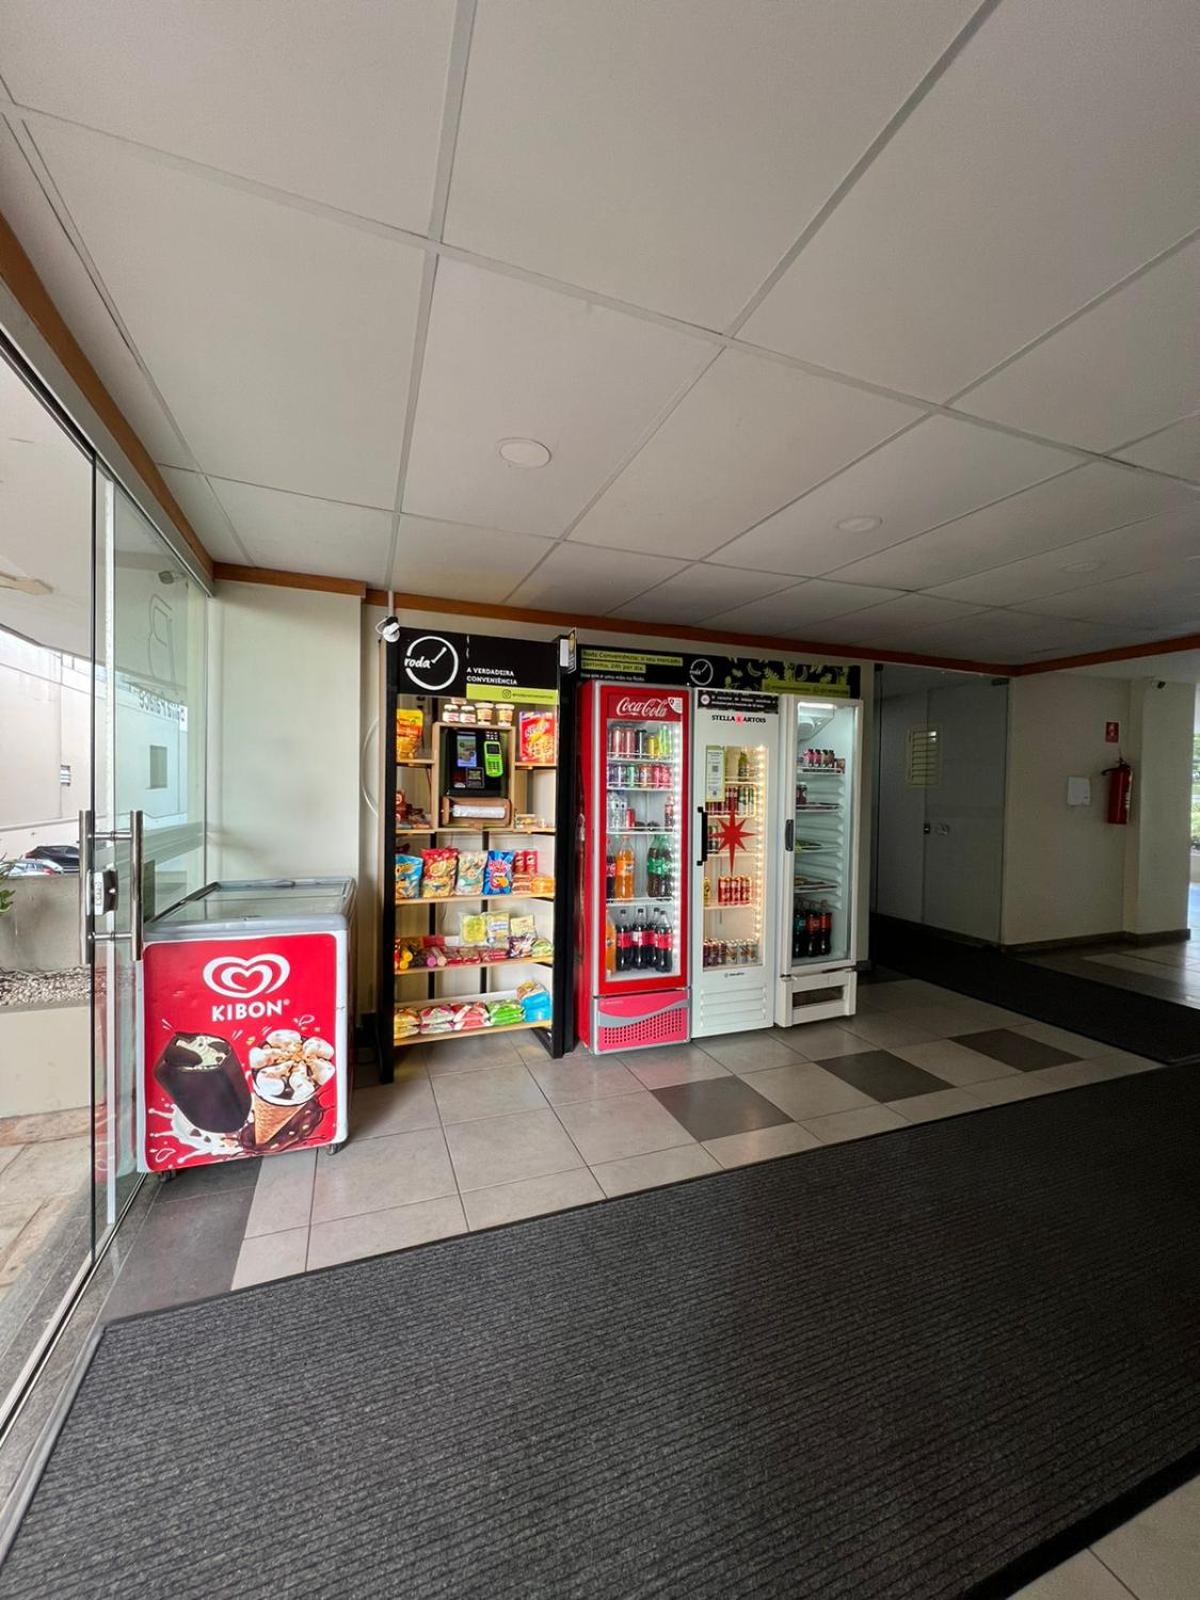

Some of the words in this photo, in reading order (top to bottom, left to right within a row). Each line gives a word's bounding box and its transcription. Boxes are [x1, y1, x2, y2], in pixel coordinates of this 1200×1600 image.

[404, 655, 431, 669] roda
[473, 667, 515, 676] VERDADEIRA
[466, 675, 518, 685] CONVENIÊNCIA
[712, 714, 736, 722] STELLA
[212, 999, 283, 1022] KIBON
